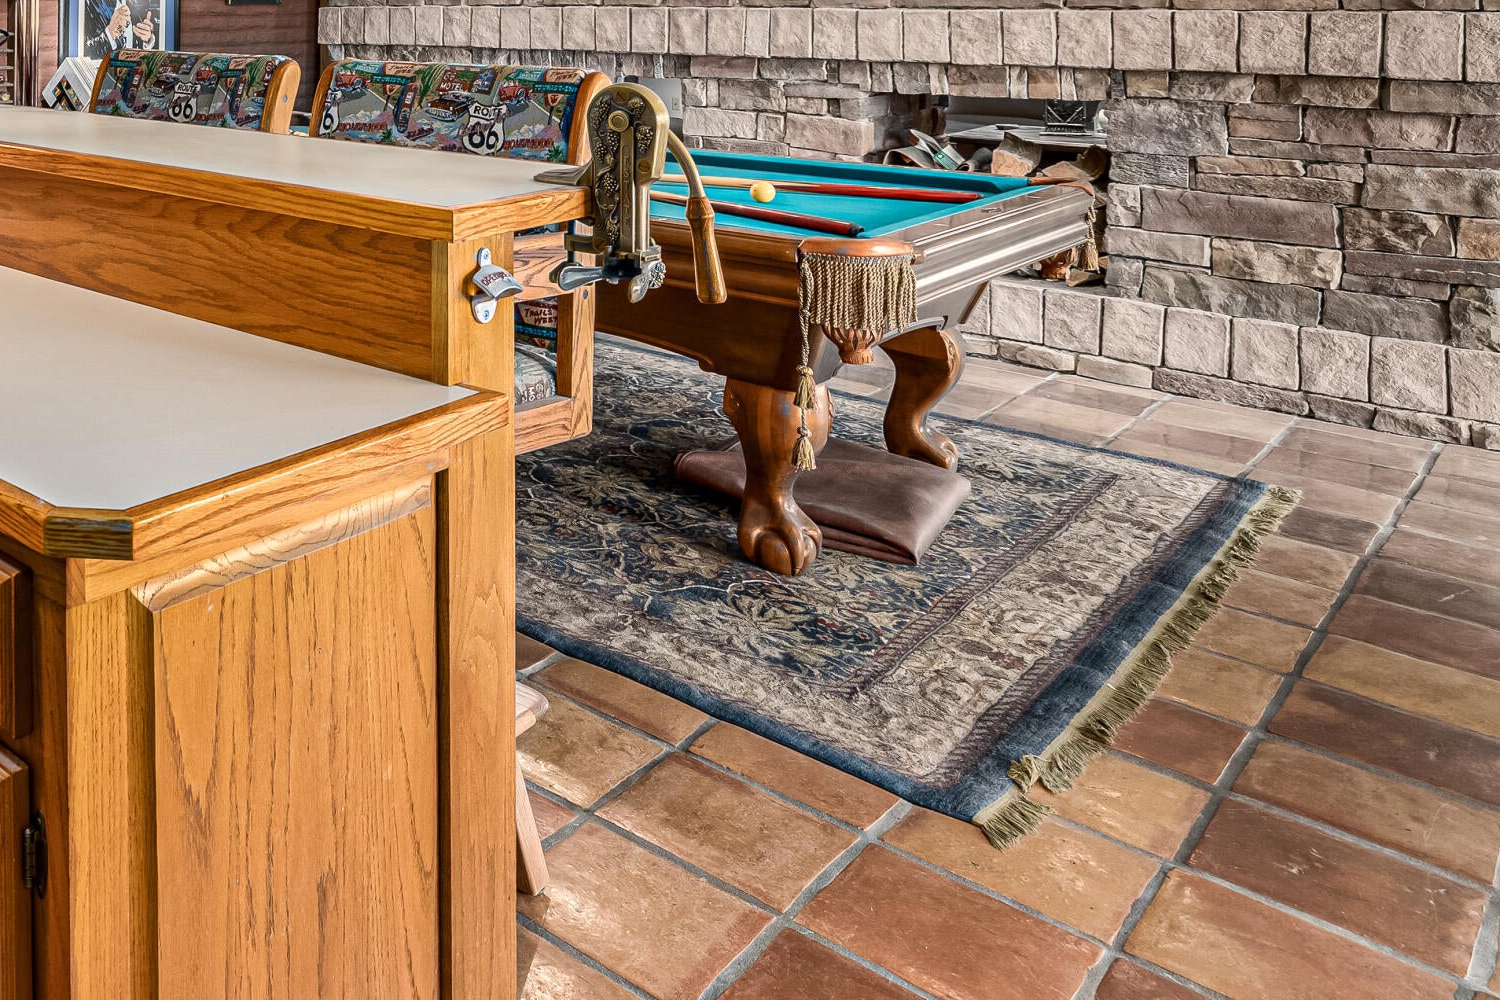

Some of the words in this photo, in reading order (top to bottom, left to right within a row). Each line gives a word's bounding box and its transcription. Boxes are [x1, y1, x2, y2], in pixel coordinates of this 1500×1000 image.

[177, 83, 198, 93] ROUTE
[623, 156, 632, 227] ESTATE
[524, 308, 553, 317] TRAILS
